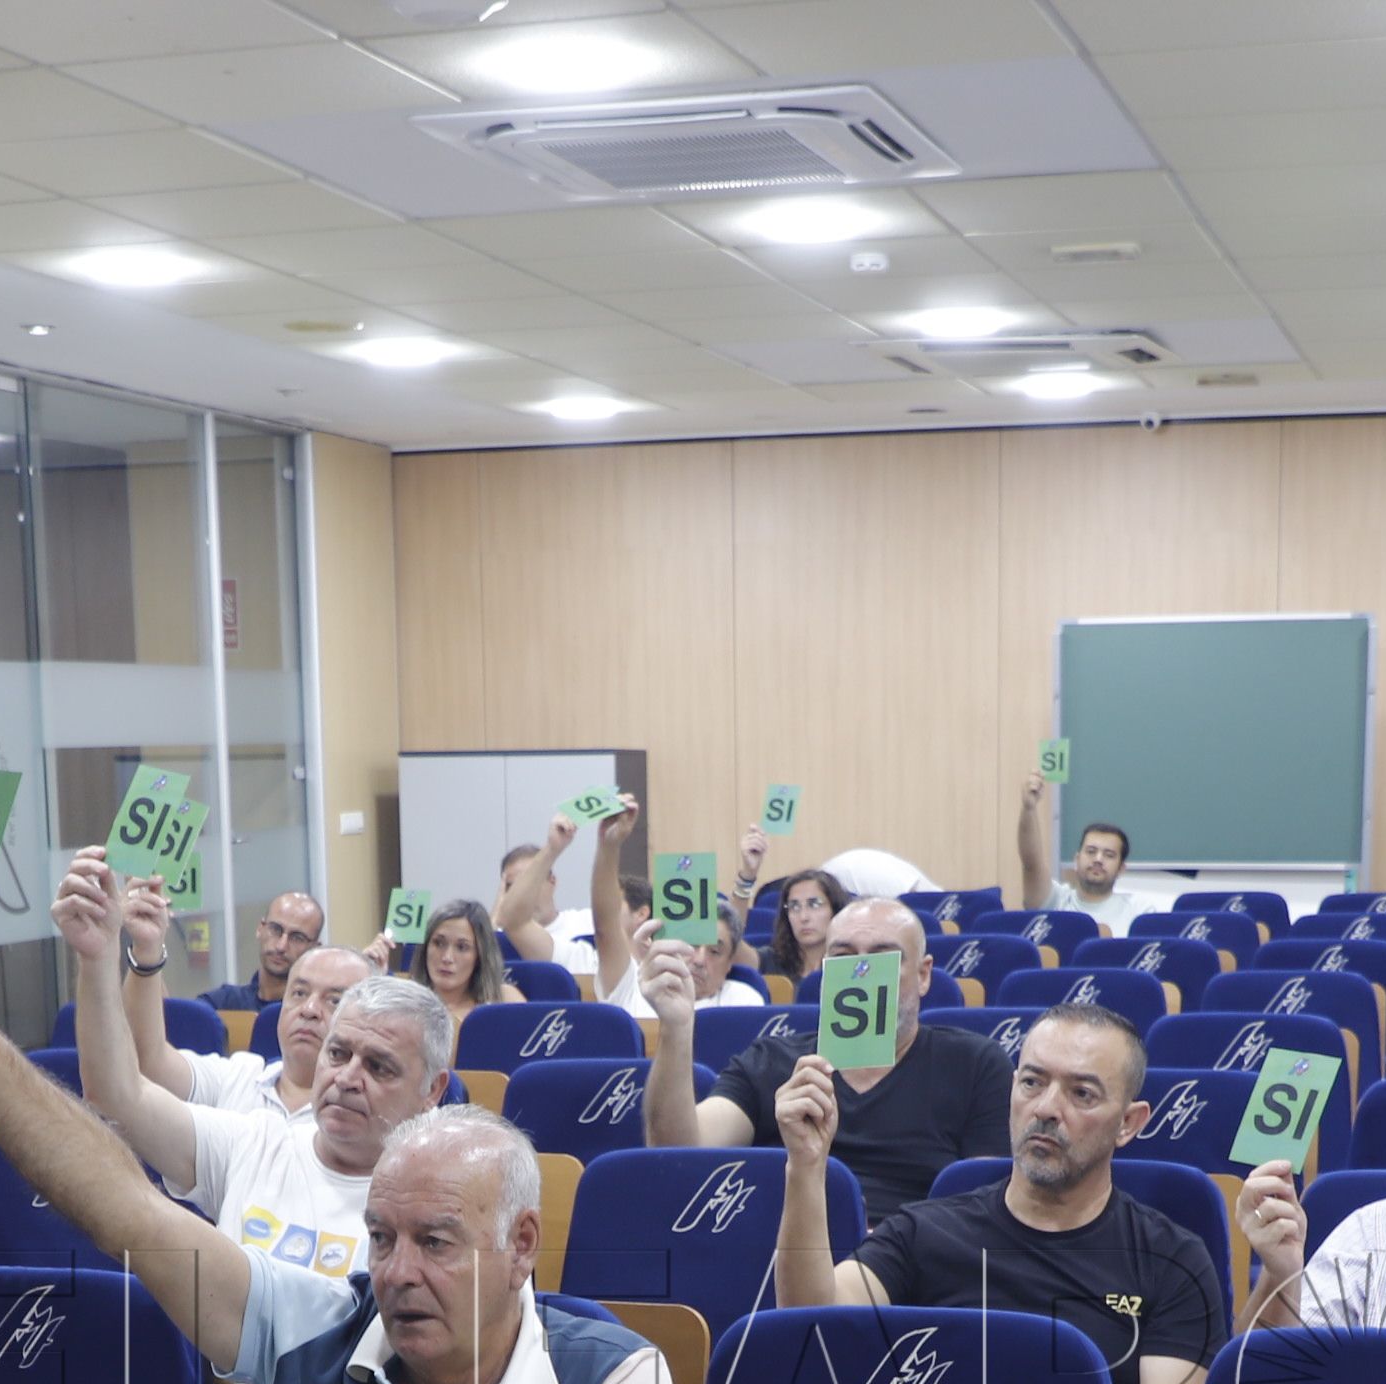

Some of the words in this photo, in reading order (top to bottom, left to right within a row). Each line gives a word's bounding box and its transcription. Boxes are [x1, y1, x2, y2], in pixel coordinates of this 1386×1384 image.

[1042, 752, 1063, 771] SI
[575, 796, 610, 818] SI
[767, 798, 794, 822] SI
[120, 797, 171, 850] SI
[661, 878, 708, 921] SI
[393, 904, 424, 928] SI
[830, 985, 887, 1038] SI
[1254, 1083, 1319, 1140] SI
[1106, 1293, 1142, 1312] EA7
